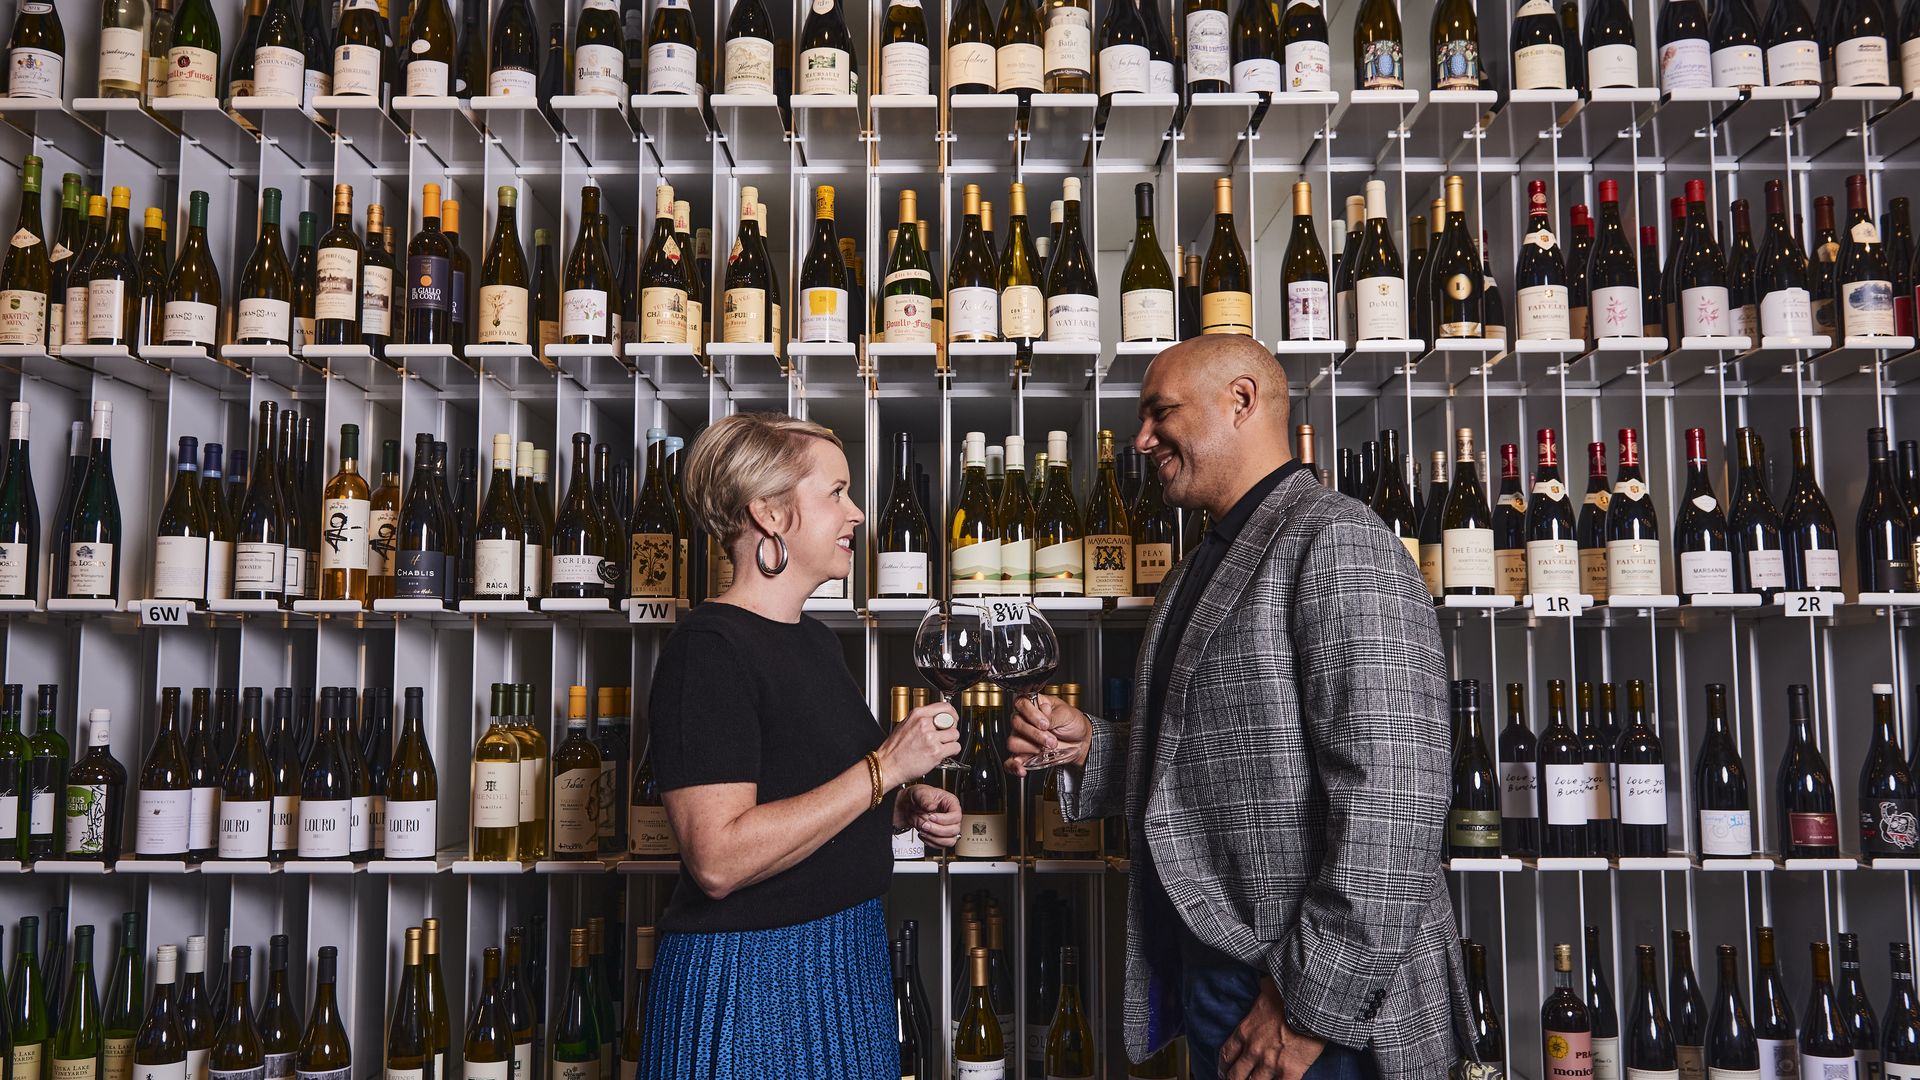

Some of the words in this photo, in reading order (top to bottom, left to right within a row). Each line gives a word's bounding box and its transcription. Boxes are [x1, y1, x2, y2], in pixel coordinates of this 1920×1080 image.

[418, 287, 441, 295] GIALLO
[418, 292, 441, 300] COSTA
[397, 568, 436, 577] CHABLIS
[1547, 597, 1570, 612] 1R
[1797, 596, 1821, 612] 2R
[149, 606, 180, 622] 6W
[637, 603, 669, 619] 7W
[1506, 774, 1528, 782] Love
[1554, 776, 1578, 785] Love
[1627, 776, 1651, 786] Love
[1508, 784, 1537, 793] Bunche
[272, 813, 293, 826] URO
[304, 818, 336, 832] LOURO
[221, 819, 250, 833] LOURO
[389, 819, 420, 832] LOURO
[14, 1055, 34, 1063] YARDS
